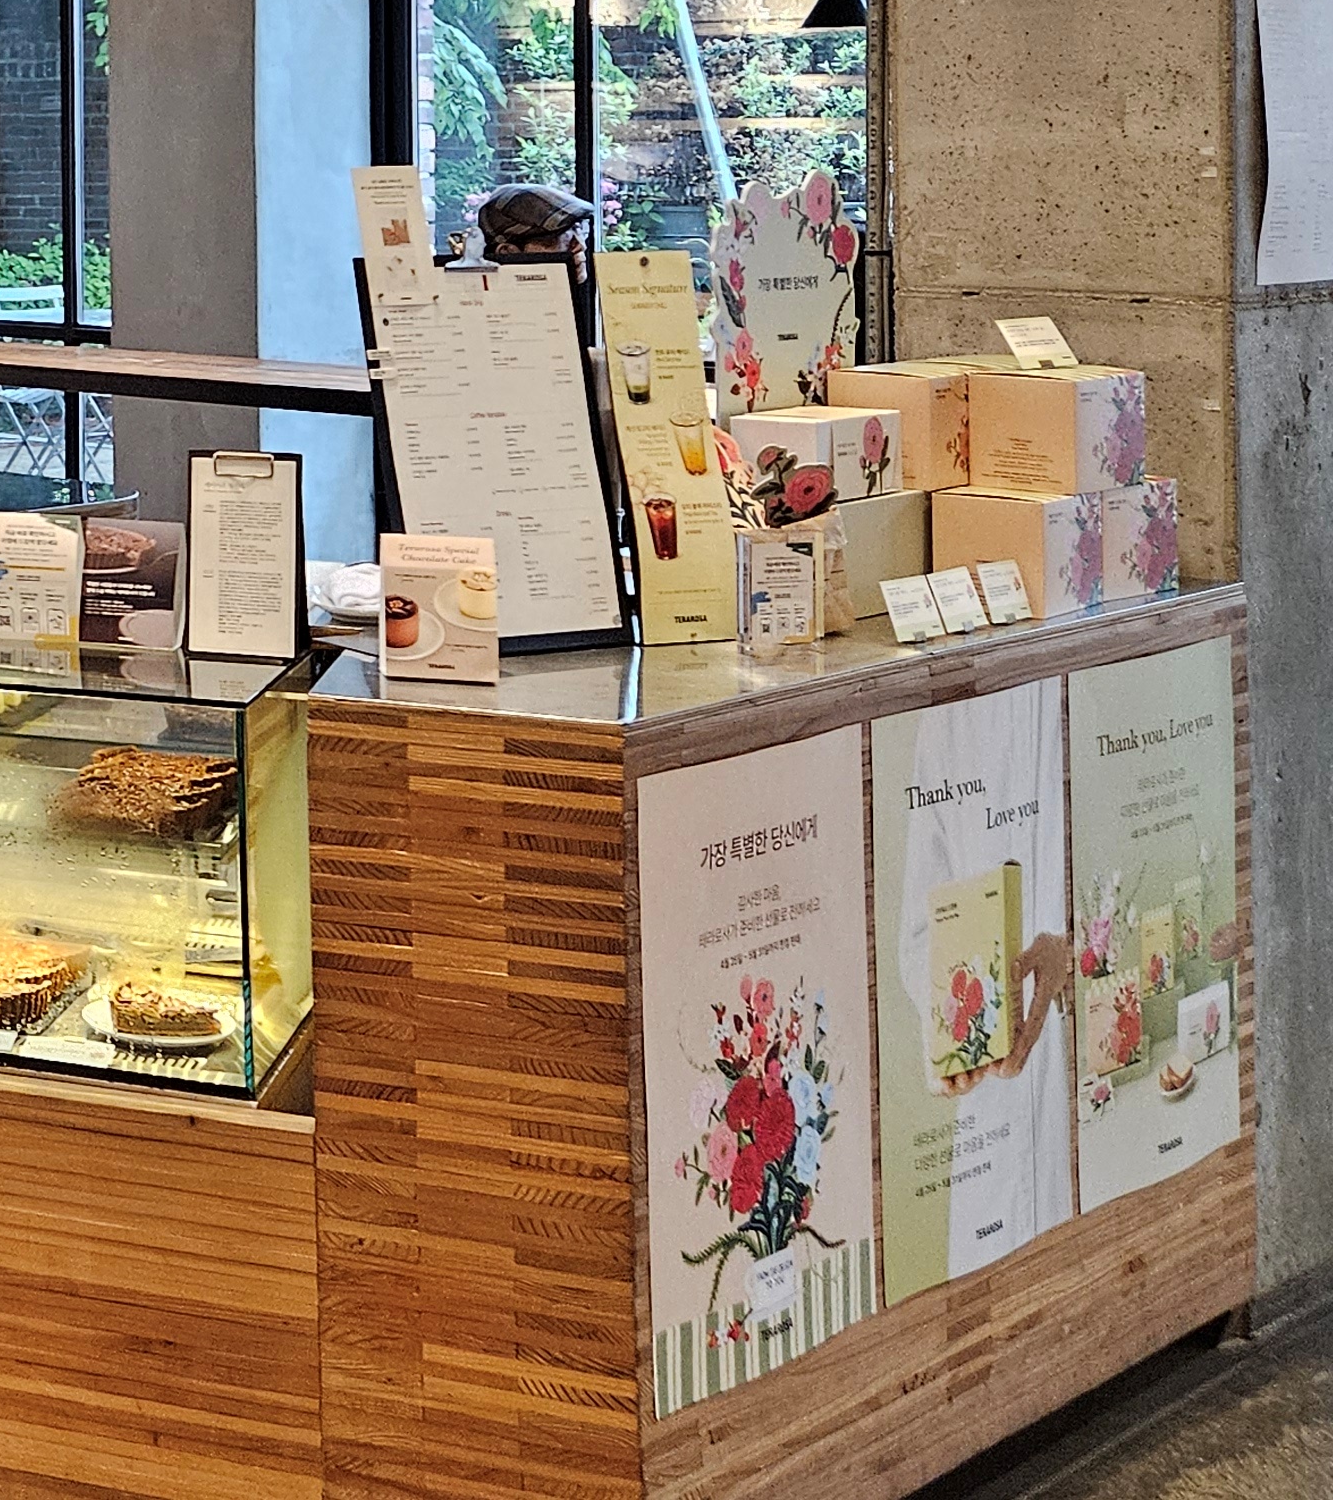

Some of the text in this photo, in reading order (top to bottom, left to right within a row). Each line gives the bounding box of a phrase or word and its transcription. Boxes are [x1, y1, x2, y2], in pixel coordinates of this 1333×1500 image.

[606, 283, 688, 297] Season Signature
[401, 553, 449, 563] Chocolate
[444, 545, 480, 555] Special
[674, 615, 708, 624] TERAROSA
[1097, 729, 1139, 756] Thank
[1169, 719, 1193, 739] Love
[905, 778, 986, 810] Thank you,
[986, 800, 1039, 830] Love you
[700, 814, 818, 870] 가장 특별한 당신에게
